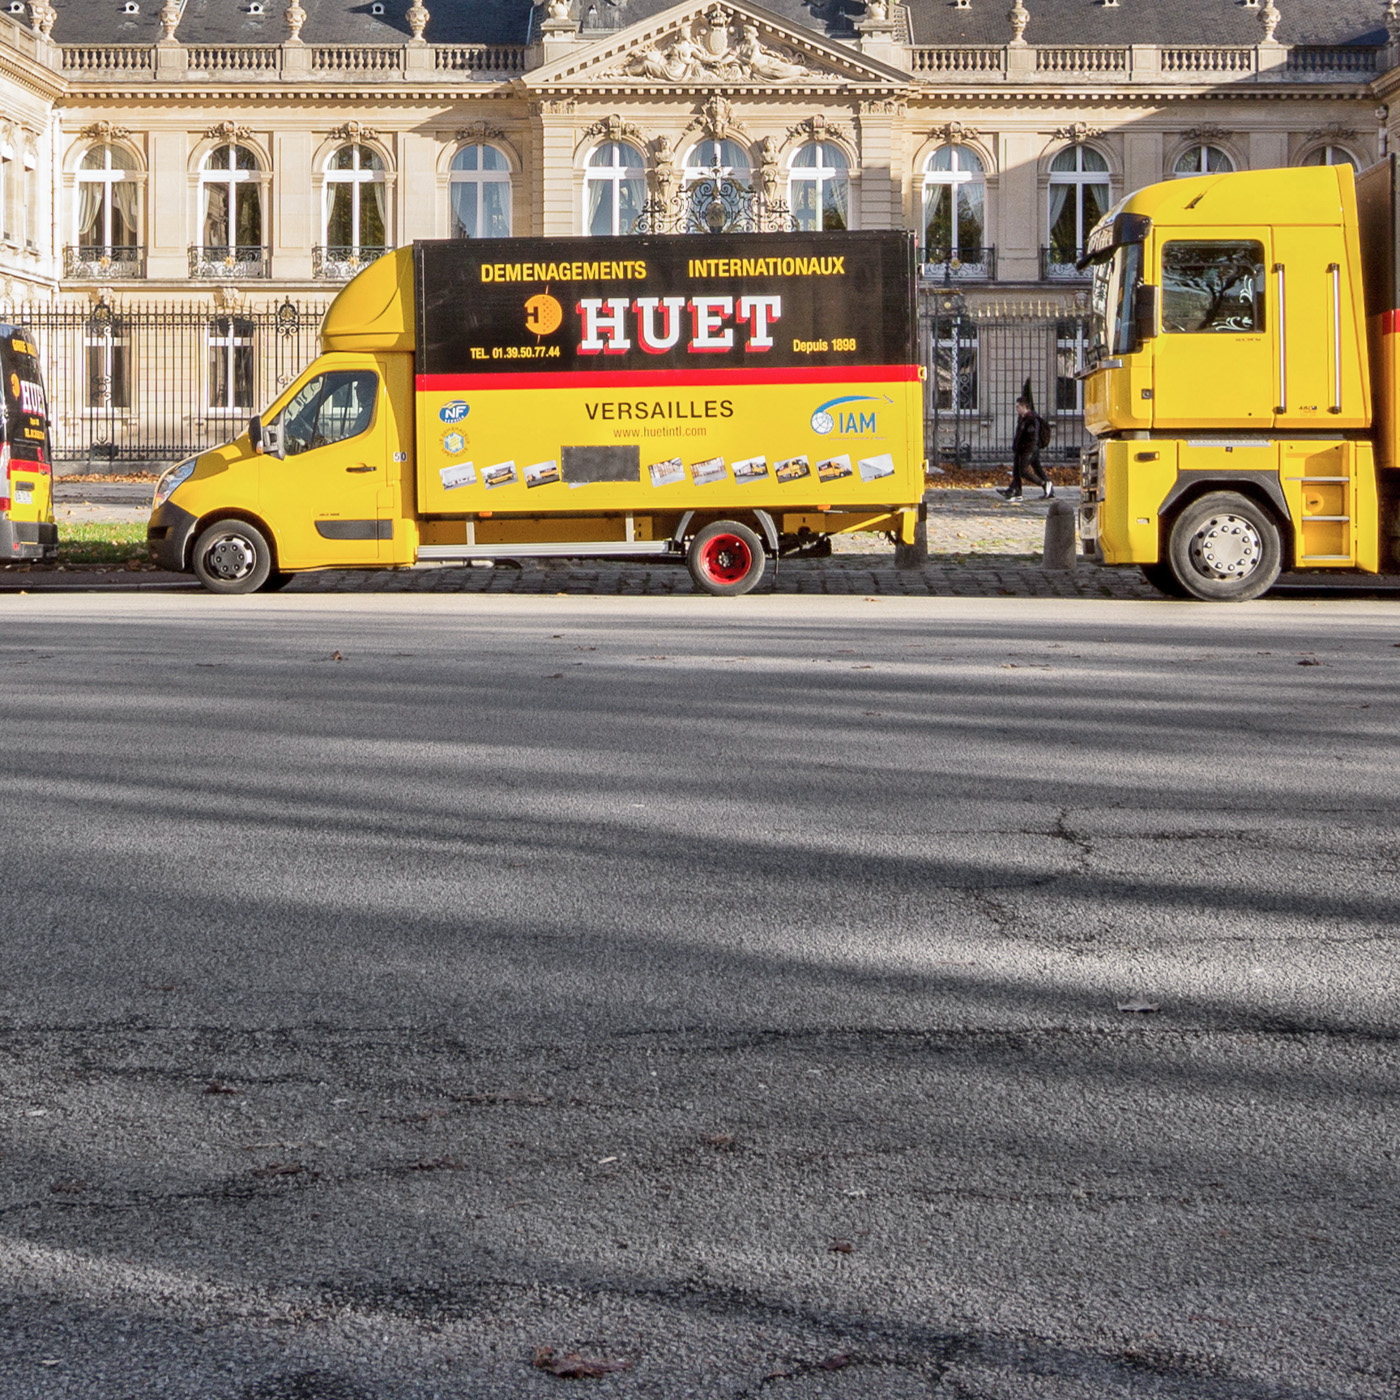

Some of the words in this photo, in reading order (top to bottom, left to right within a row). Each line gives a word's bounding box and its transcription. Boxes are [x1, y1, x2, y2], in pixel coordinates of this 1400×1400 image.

[480, 260, 648, 283] DEMENAGEMENTS
[688, 255, 846, 279] INTERNATIONAUX
[575, 294, 784, 356] HUET
[469, 346, 491, 360] TEL.
[491, 345, 562, 359] 01.39.50.77.44
[792, 338, 828, 356] Depuis
[829, 337, 858, 352] 1898
[444, 405, 466, 419] NF
[584, 399, 734, 421] VERSAILLES
[612, 424, 708, 439] www.huetintl.com
[839, 411, 876, 434] IAM
[394, 452, 407, 461] 50
